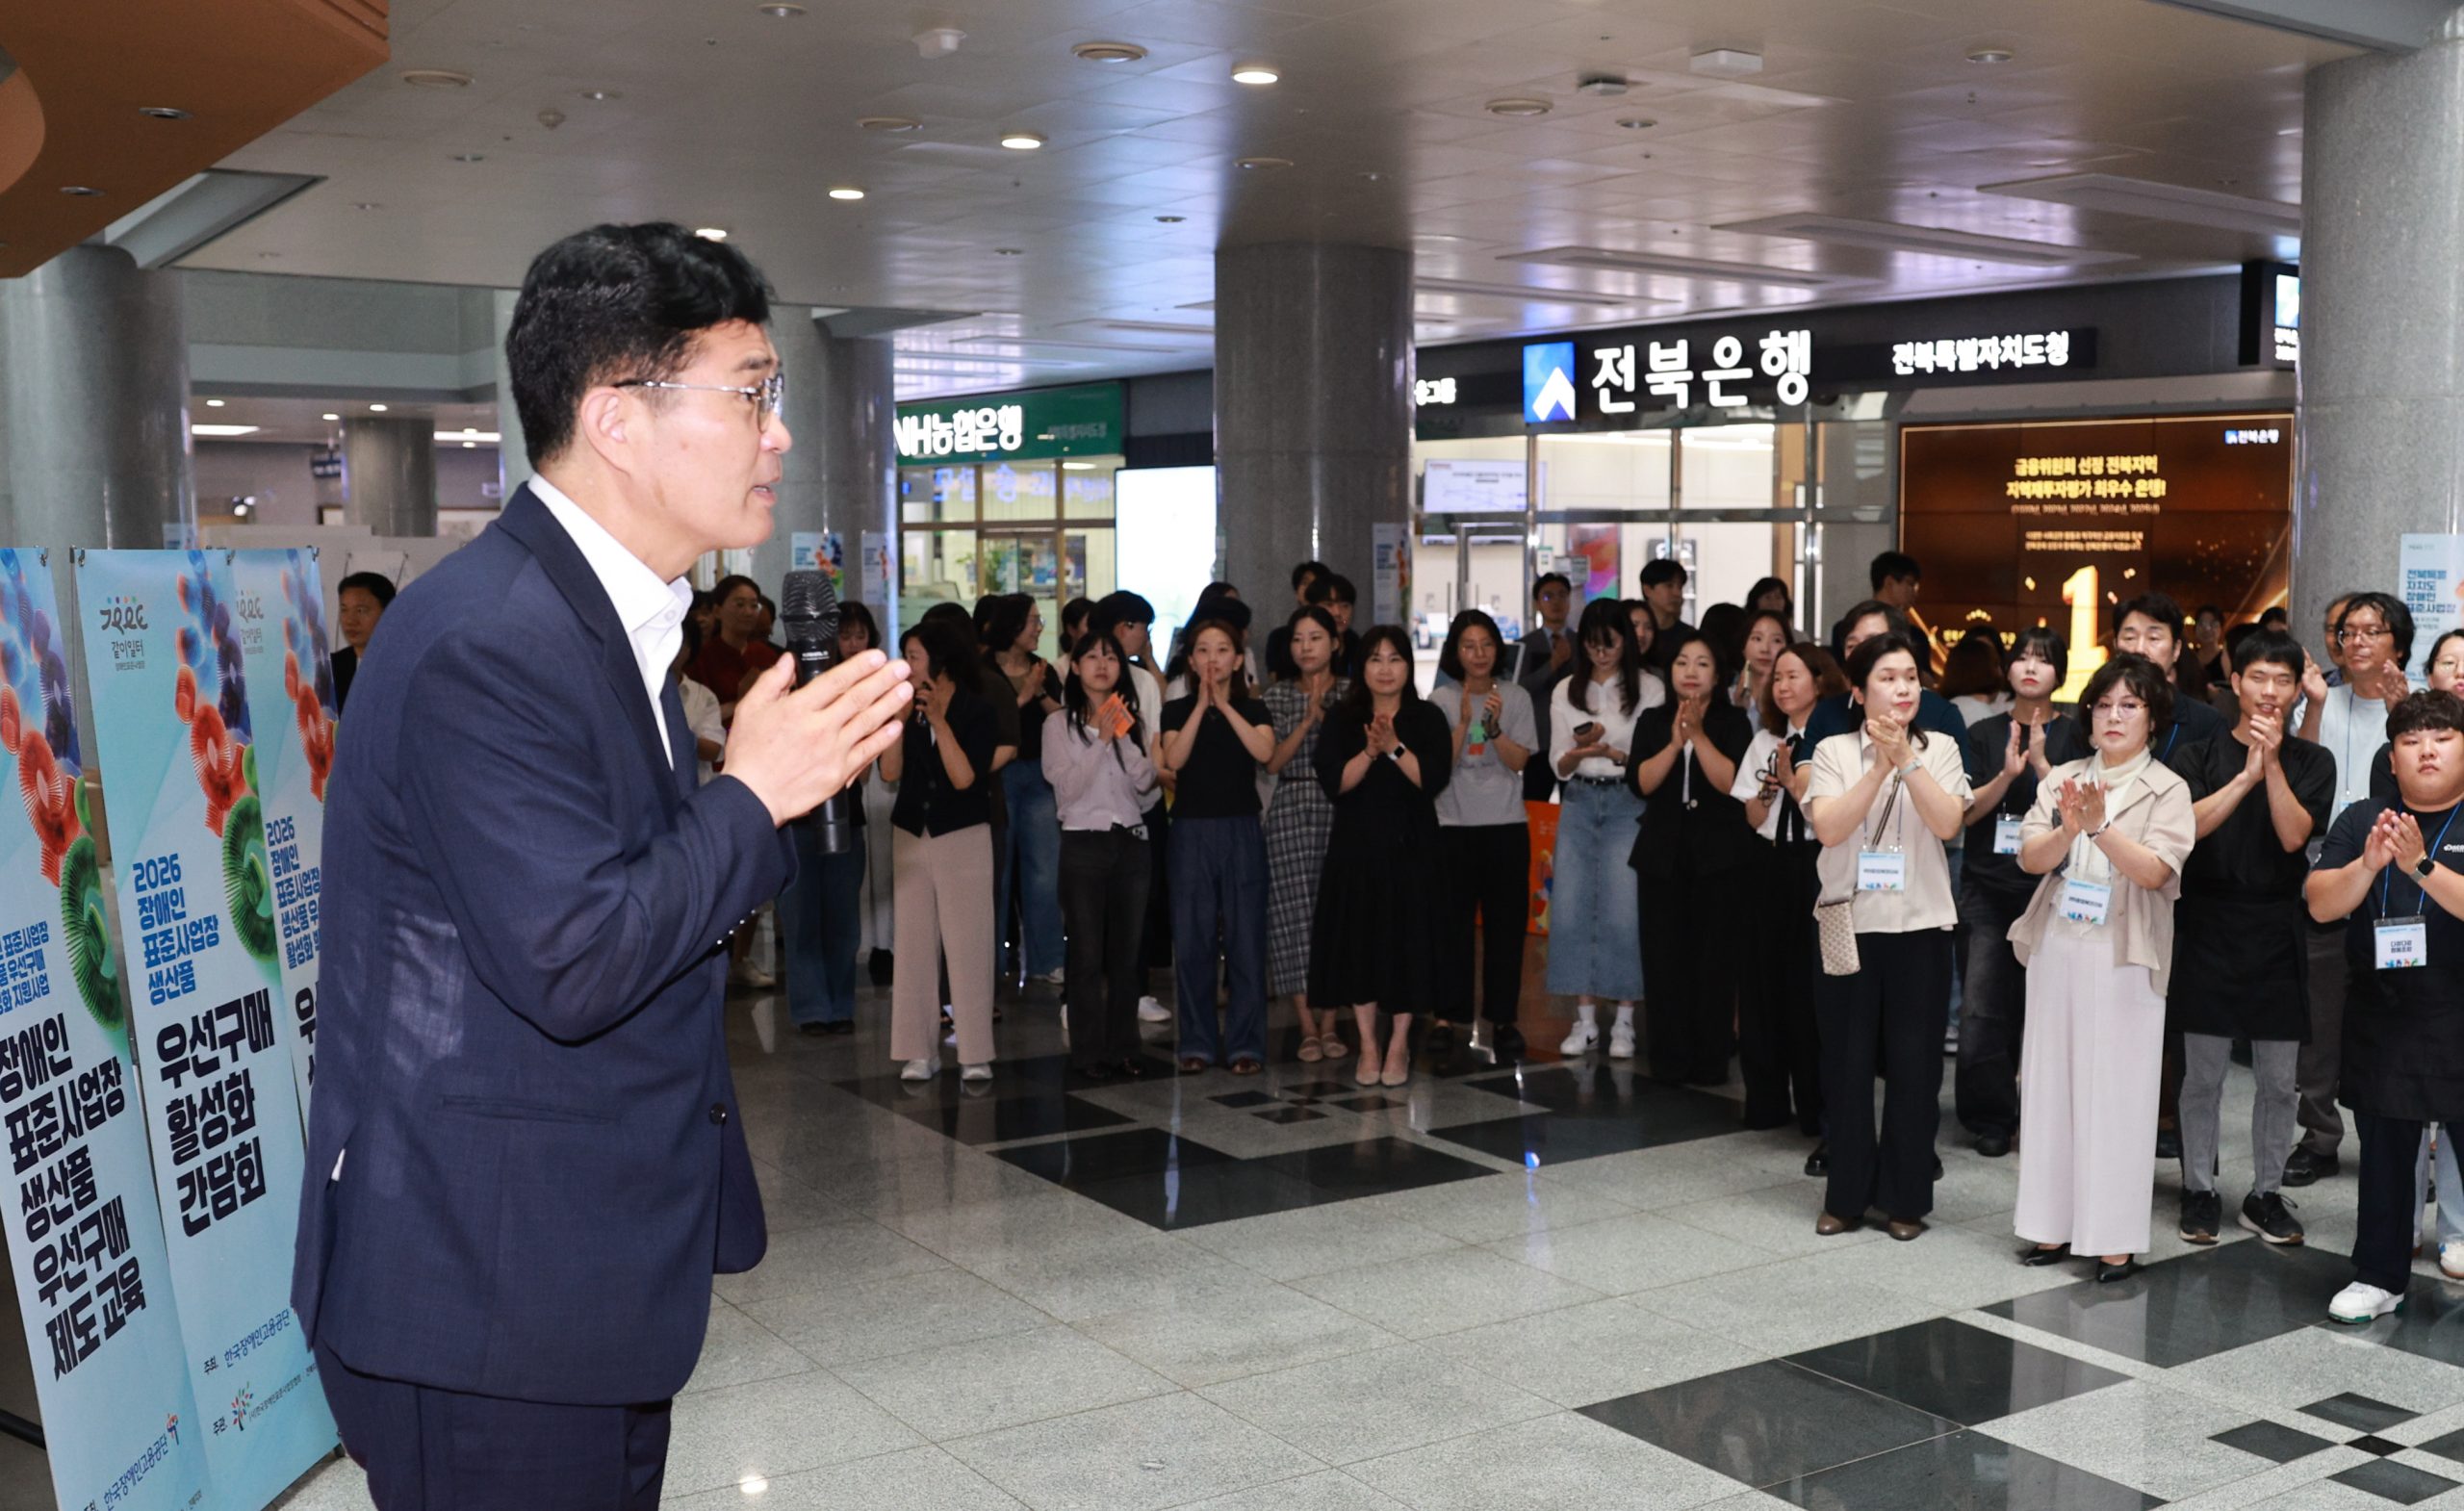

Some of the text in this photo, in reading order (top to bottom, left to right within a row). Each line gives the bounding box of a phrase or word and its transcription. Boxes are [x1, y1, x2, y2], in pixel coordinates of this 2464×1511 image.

[1592, 330, 1810, 413] 전북은행
[1892, 330, 2069, 375] 전북특별자치도청
[2238, 429, 2279, 444] 전북은행
[2078, 455, 2104, 475] 선정
[2106, 454, 2158, 474] 전북지역
[2093, 478, 2133, 499] 최우수
[111, 639, 145, 659] 같이일터
[266, 816, 295, 847] 2026
[133, 853, 181, 893] 2026
[270, 843, 299, 878] 장애인
[138, 886, 187, 931] 장애인
[275, 866, 321, 909] 표준사업장
[3, 921, 49, 958] 표준사업장
[141, 914, 219, 968] 표준사업장
[281, 901, 310, 939] 생산품
[8, 948, 45, 982] 우선구매
[148, 960, 196, 1006] 생산품
[12, 972, 50, 1008] 지원사업
[0, 1012, 73, 1104] 장애인
[157, 987, 275, 1088] 우선구매
[4, 1056, 125, 1176] 표준사업장
[166, 1067, 256, 1166] 활성화
[21, 1144, 98, 1243] 생산품
[176, 1136, 267, 1238] 간담회
[33, 1194, 131, 1308] 우선구매
[45, 1256, 147, 1383] 제도 교육
[224, 1309, 290, 1369] 한국장애인고용공단
[103, 1433, 168, 1511] 한국장애인고용공단
